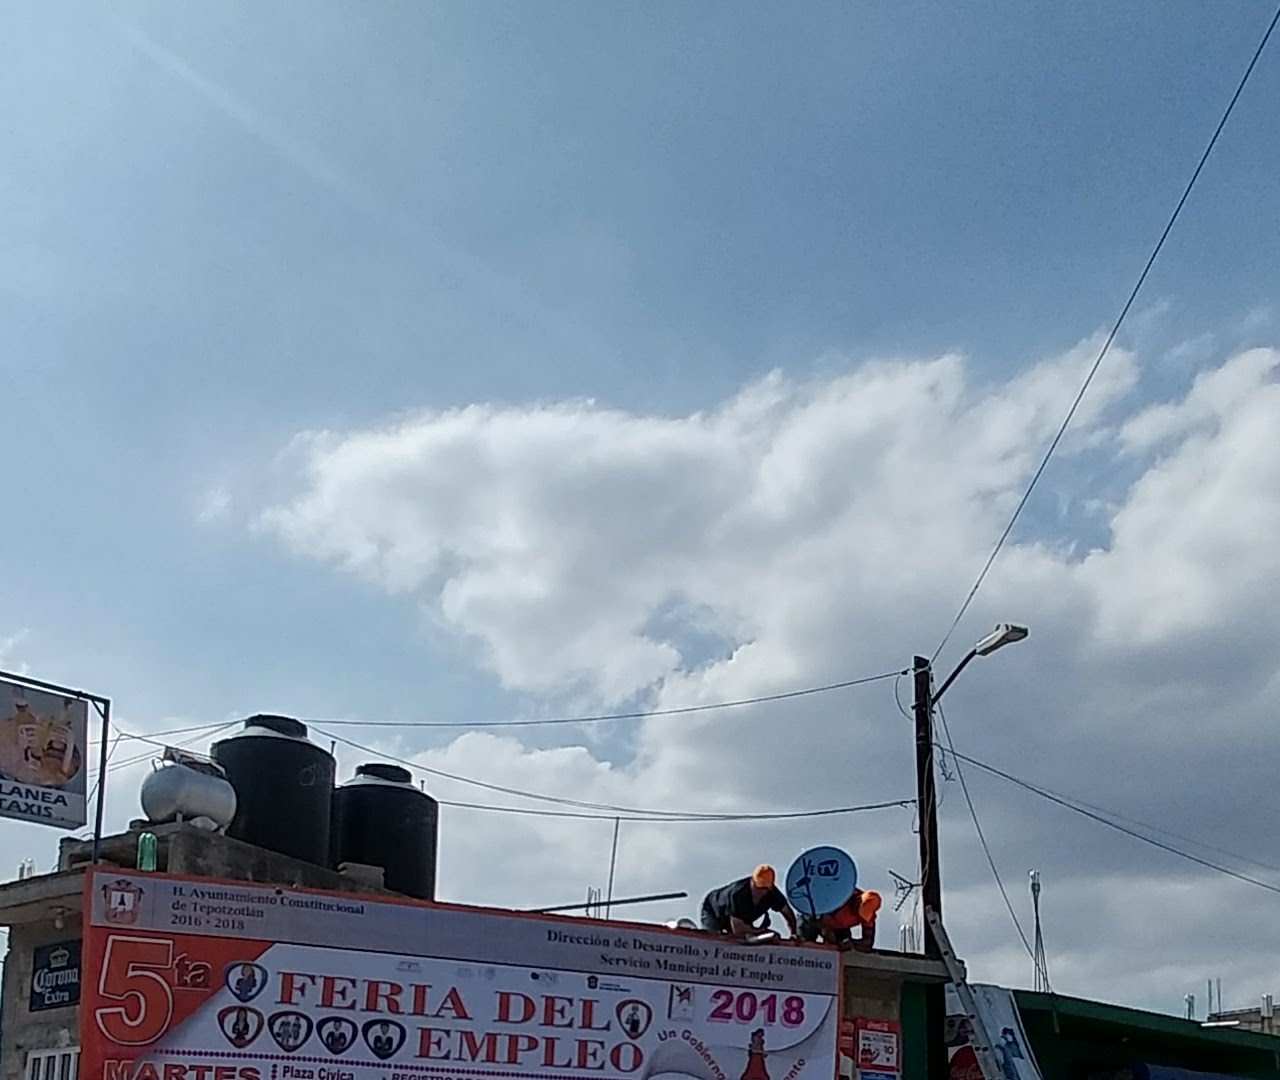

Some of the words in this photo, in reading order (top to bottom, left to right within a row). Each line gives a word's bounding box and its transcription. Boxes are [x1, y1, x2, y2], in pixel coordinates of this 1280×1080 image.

[171, 901, 188, 911] de
[173, 886, 186, 897] H.
[190, 887, 277, 905] Ayuntamiento
[280, 896, 365, 915] Constitucional
[171, 914, 202, 926] 2016
[214, 918, 245, 930] 2018
[547, 929, 610, 948] Dirección
[614, 937, 629, 949] de
[633, 939, 699, 956] Desarrollo
[703, 948, 710, 959] y
[714, 947, 766, 964] Fomento
[769, 952, 833, 970] Económico
[33, 968, 79, 993] Corona
[600, 954, 651, 969] Servicio
[655, 959, 720, 976] Municipal
[722, 966, 737, 977] de
[740, 968, 784, 983] Empleo
[44, 988, 69, 1004] Extra
[96, 935, 212, 1046] 5ta
[275, 971, 473, 1020] FERIA
[494, 990, 611, 1031] DEL
[710, 990, 805, 1026] 2018
[415, 1026, 644, 1073] EMPLEO
[657, 1029, 677, 1042] Un
[282, 1065, 314, 1080] Plaza
